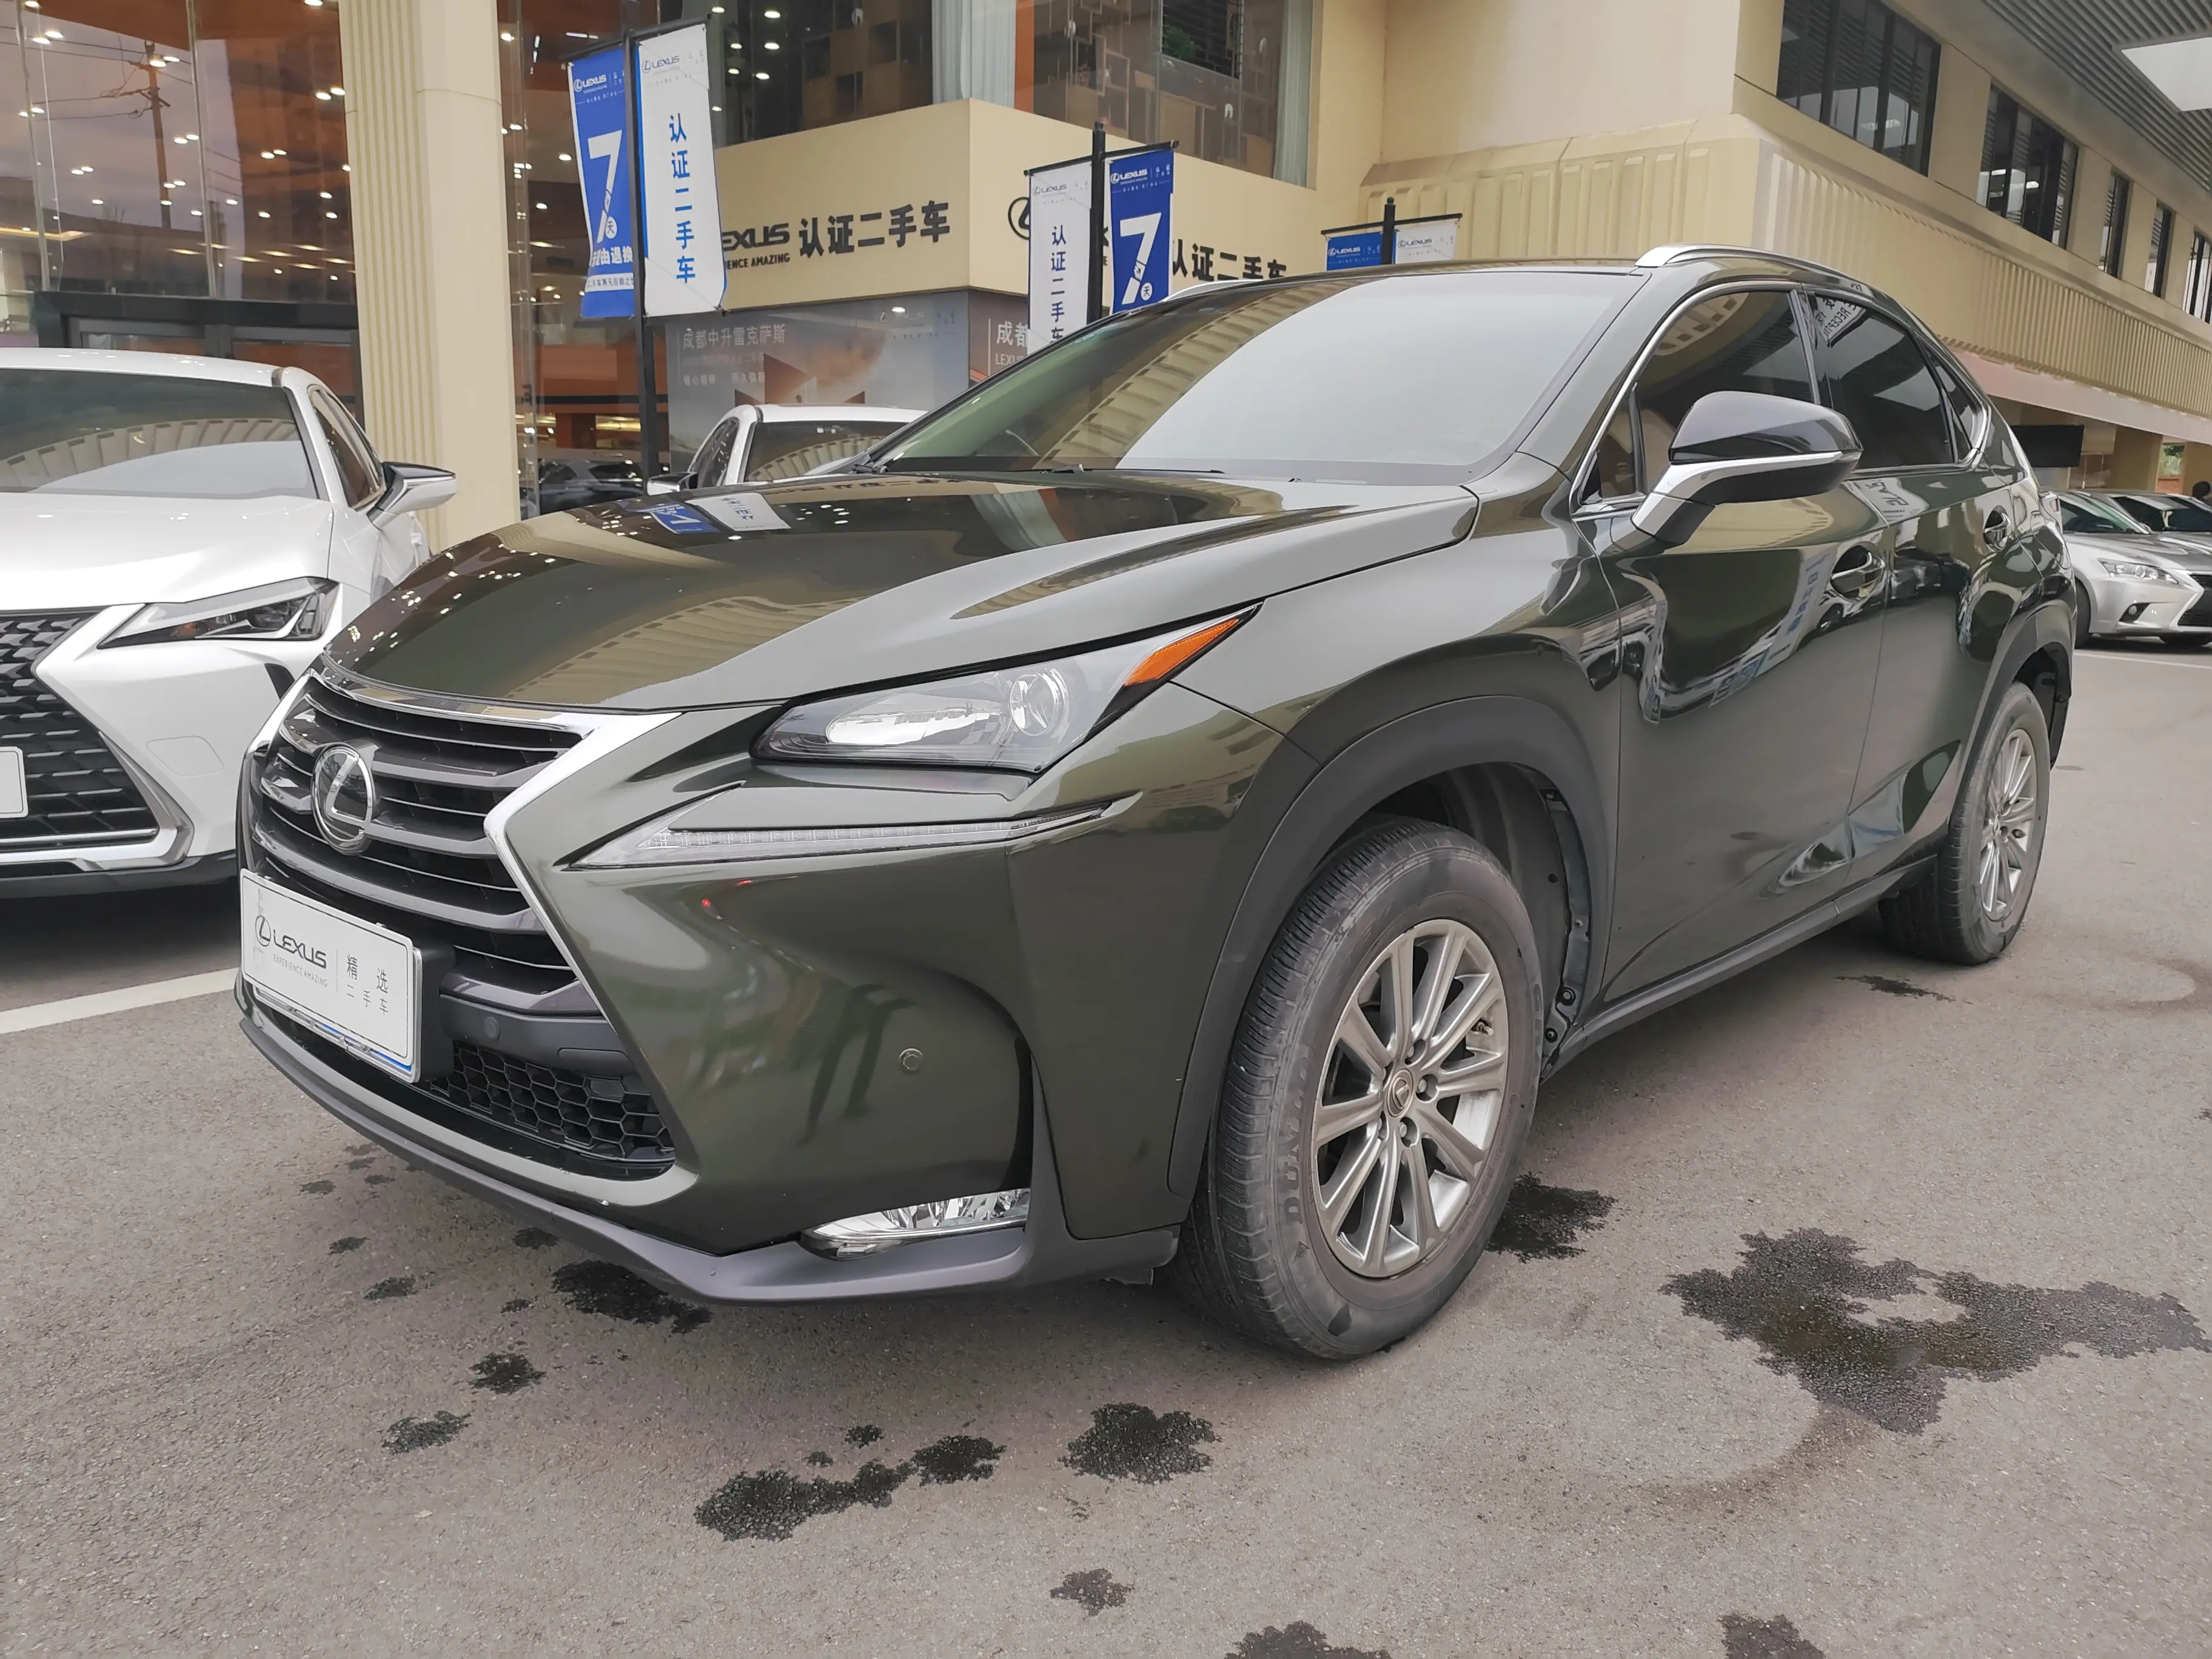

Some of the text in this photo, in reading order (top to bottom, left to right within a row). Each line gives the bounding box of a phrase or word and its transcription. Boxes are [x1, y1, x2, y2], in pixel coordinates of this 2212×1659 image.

[652, 55, 680, 68] LEXUS
[583, 74, 607, 87] LEXUS
[588, 130, 623, 244] 7
[1119, 168, 1148, 181] LEXUS
[669, 113, 696, 283] 认证二手车
[1041, 184, 1067, 193] LEXUS
[608, 220, 615, 234] 天
[799, 200, 950, 258] 认证二手车
[1406, 238, 1432, 247] LEXUS
[751, 253, 791, 267] AMAZING
[1120, 212, 1162, 305] 7
[1050, 224, 1067, 343] 认证二手车
[1143, 286, 1150, 297] 天
[683, 323, 786, 349] 成都中升雷克萨斯
[996, 320, 1028, 347] 成都
[273, 929, 327, 969] LEXUS
[273, 954, 328, 988] EXPERIENCE AMAZING
[346, 954, 389, 993] 精选
[346, 984, 389, 1015] 二手车
